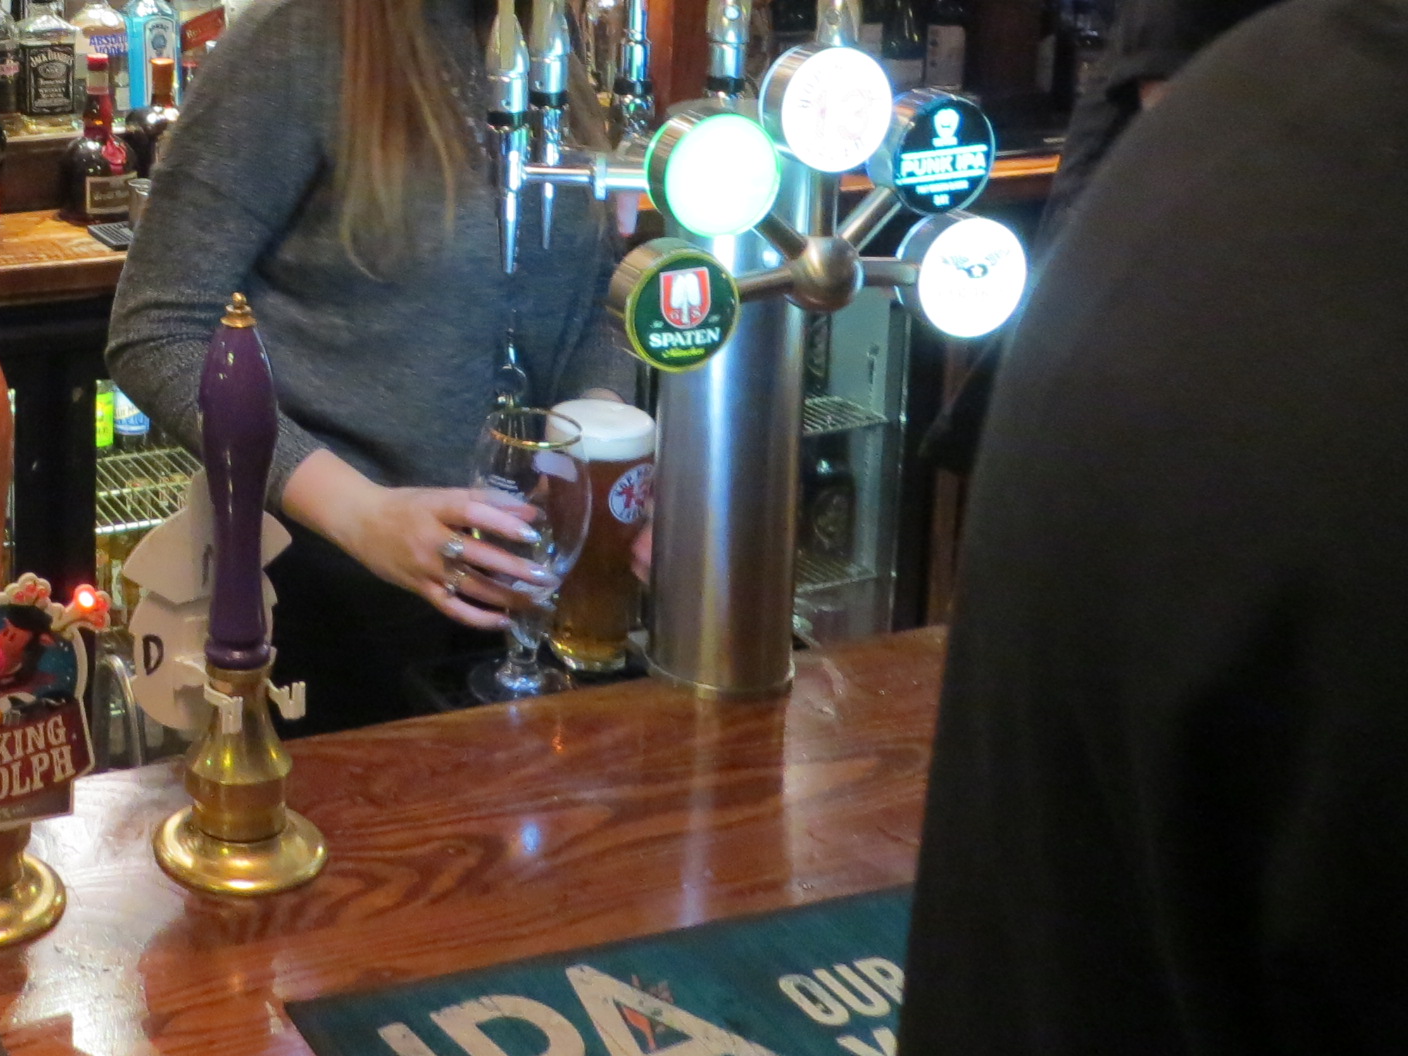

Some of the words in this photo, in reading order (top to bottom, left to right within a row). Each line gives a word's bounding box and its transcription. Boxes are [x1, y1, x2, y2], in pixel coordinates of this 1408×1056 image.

[900, 158, 954, 178] PUNK
[955, 150, 988, 172] IPA
[648, 326, 721, 349] SPATEN
[142, 633, 164, 676] D
